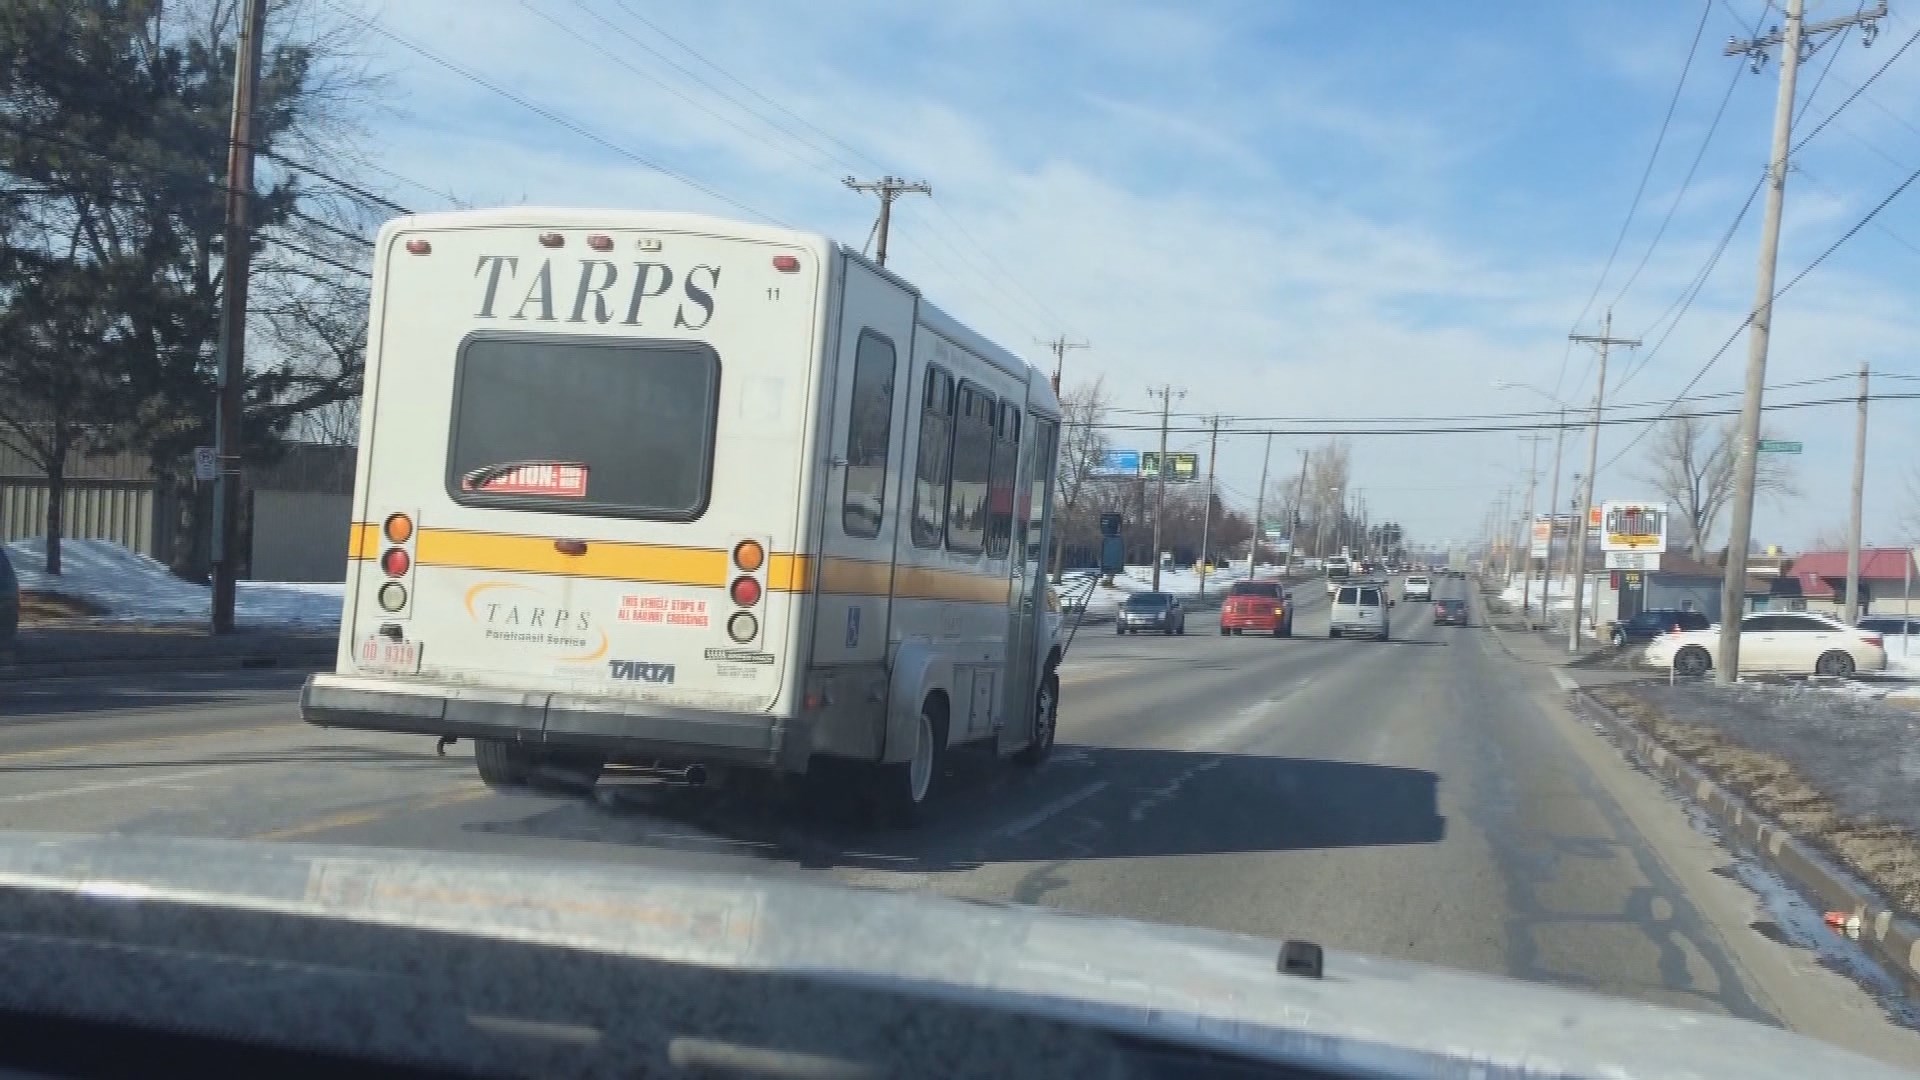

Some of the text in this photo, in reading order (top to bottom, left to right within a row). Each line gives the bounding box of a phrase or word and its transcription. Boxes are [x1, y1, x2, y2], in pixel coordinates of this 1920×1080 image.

[473, 255, 721, 330] TARPS
[766, 288, 780, 300] 11
[622, 595, 707, 613] THIS VEHICLE STOPS AT
[487, 603, 590, 631] TARPS
[618, 609, 629, 621] ALL
[666, 613, 709, 626] CROSSINGS
[486, 628, 586, 648] Paratransit Service
[608, 659, 676, 685] TARTA
